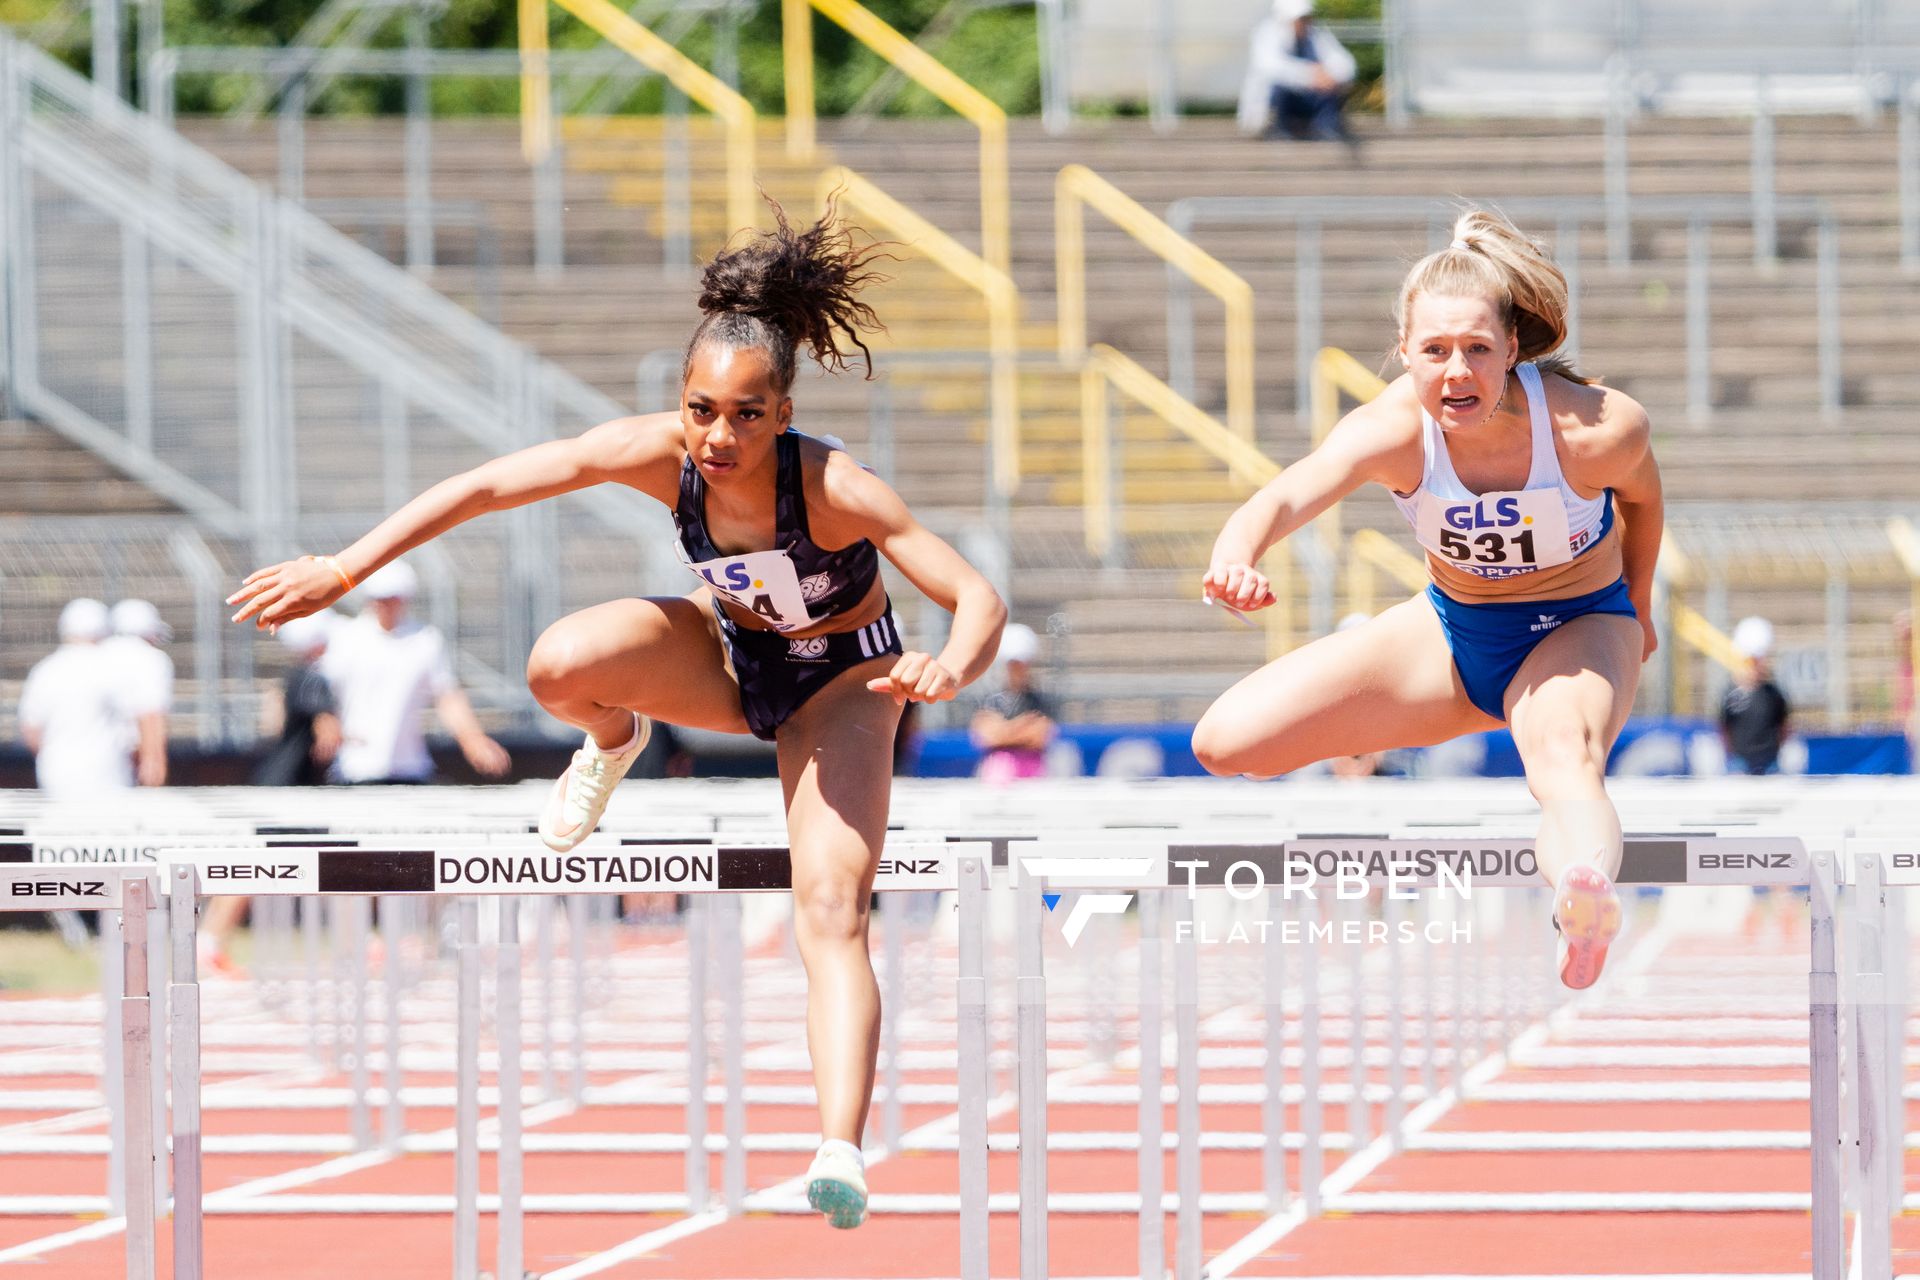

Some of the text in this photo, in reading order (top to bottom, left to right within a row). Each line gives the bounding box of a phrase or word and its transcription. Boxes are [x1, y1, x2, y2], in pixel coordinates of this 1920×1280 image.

[1444, 497, 1534, 531] GLS.
[1440, 528, 1536, 564] 531
[701, 562, 764, 592] LS.
[207, 855, 940, 885] BENZ DONAUSTADION ENZ
[1288, 849, 1792, 878] DONAUSTADIO BENZ
[11, 882, 105, 897] BENZ
